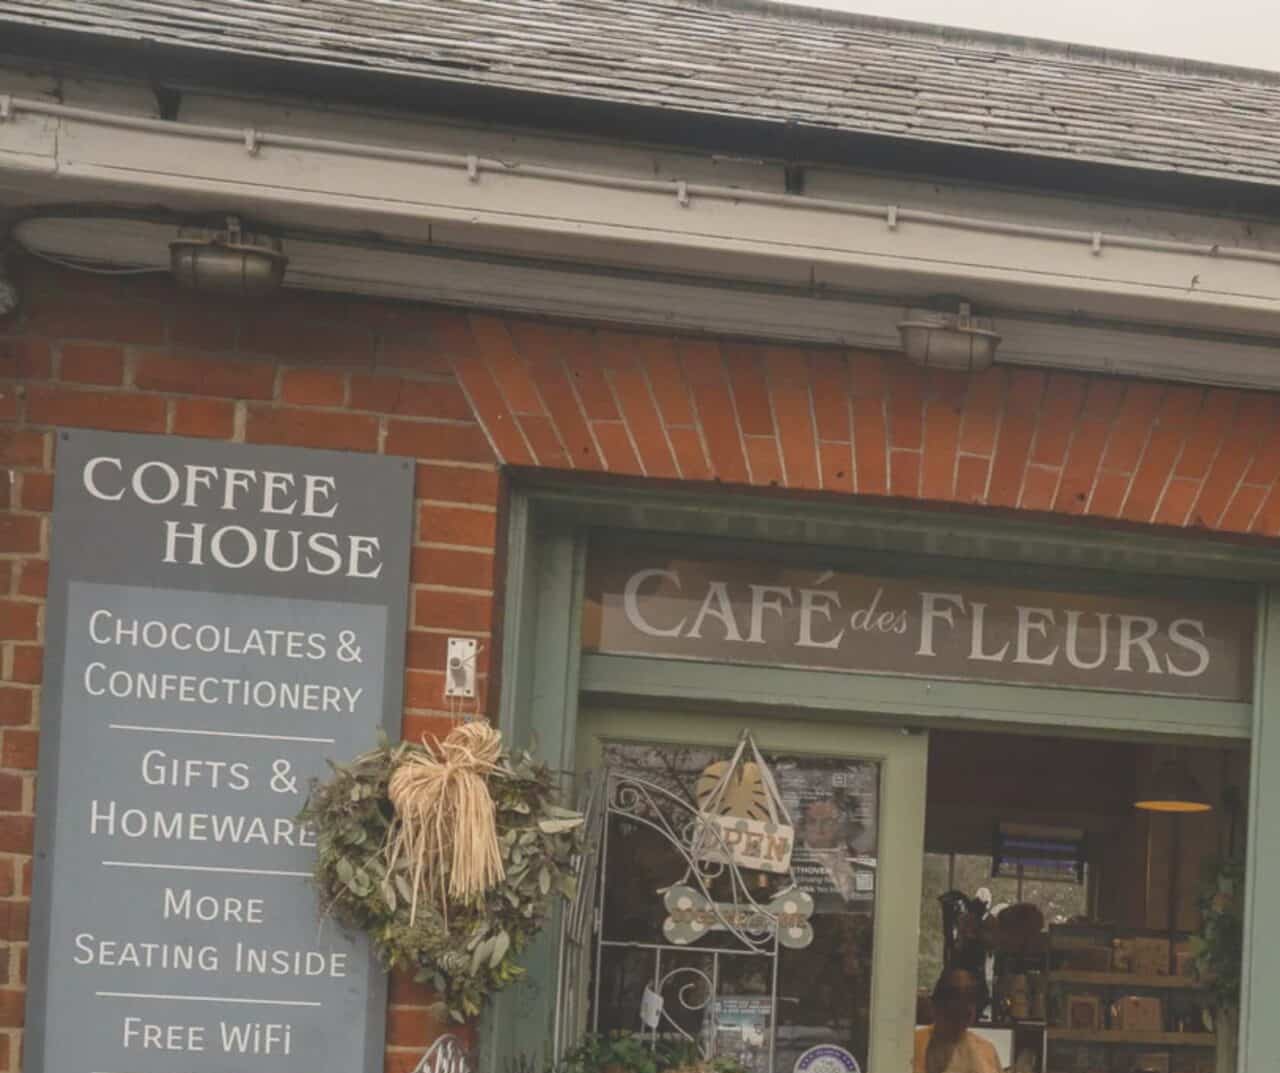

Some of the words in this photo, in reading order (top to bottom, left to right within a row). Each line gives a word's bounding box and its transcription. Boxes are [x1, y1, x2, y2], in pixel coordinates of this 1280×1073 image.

[83, 456, 339, 518] COFFEE
[162, 521, 383, 579] HOUSE
[88, 609, 327, 660] CHOCOLATES
[336, 629, 363, 664] &
[623, 567, 846, 650] CAFÉ
[850, 585, 908, 635] des
[915, 590, 1211, 678] FLEURS
[84, 662, 363, 713] CONFECTIONERY
[141, 749, 250, 792] GIFTS
[270, 759, 298, 795] &
[164, 887, 264, 924] MORE
[73, 933, 218, 972] SEATING
[235, 943, 347, 977] INSIDE
[123, 1017, 204, 1051] FREE
[220, 1021, 291, 1055] WiFi
